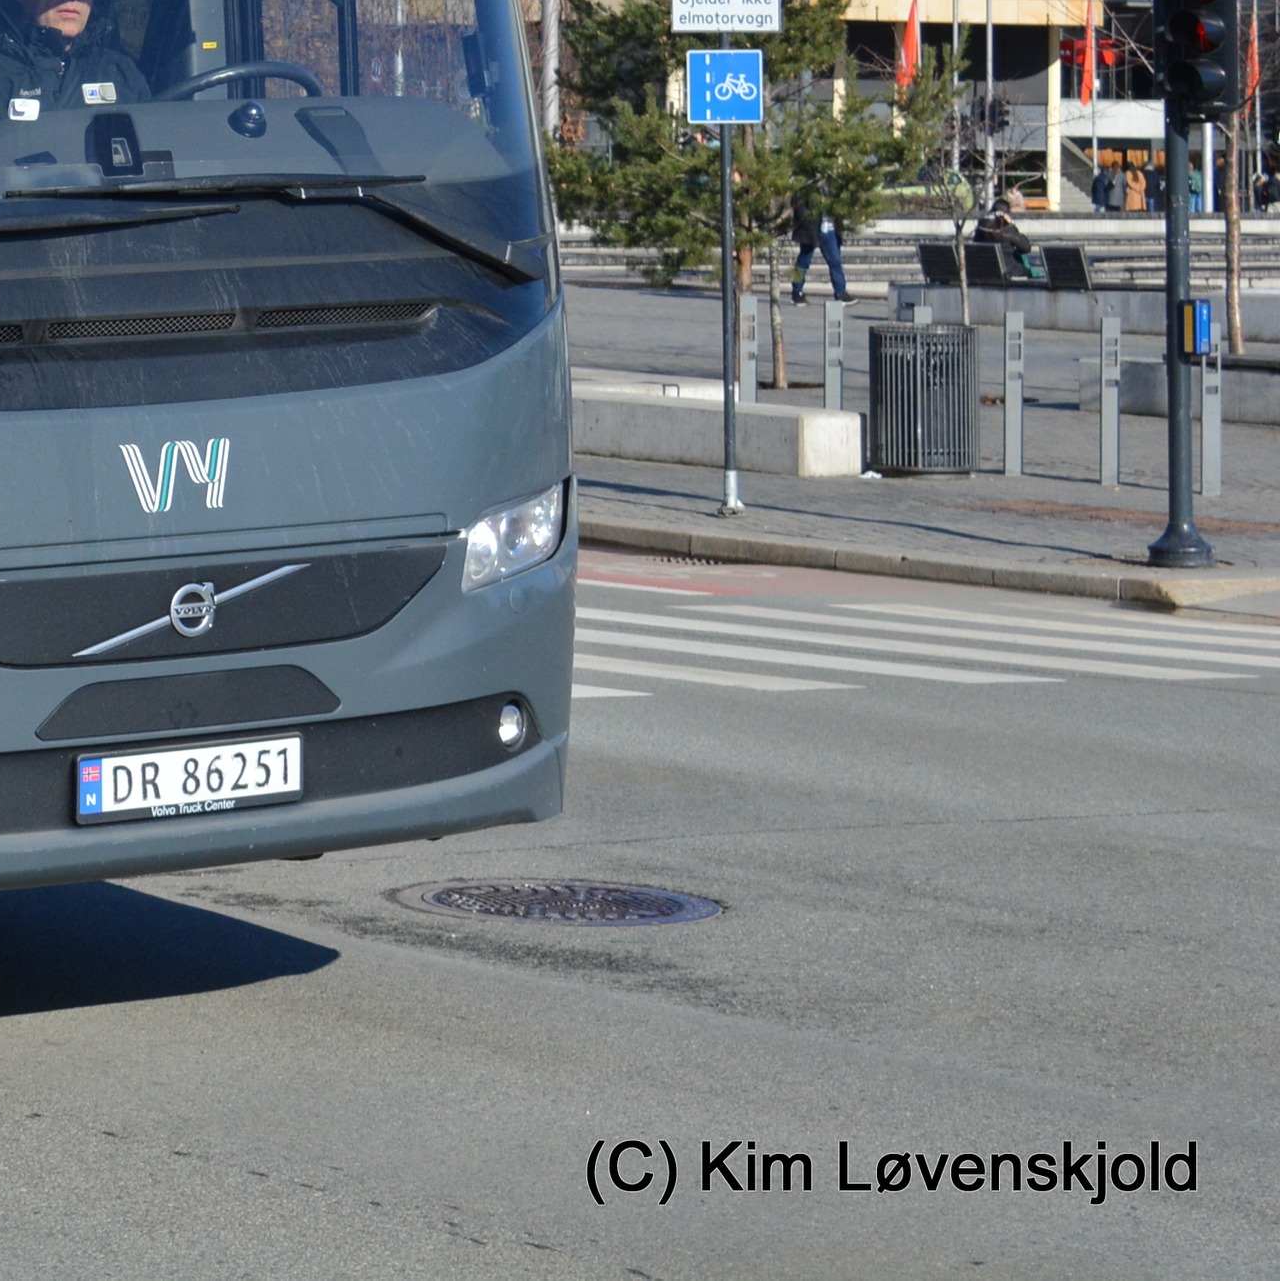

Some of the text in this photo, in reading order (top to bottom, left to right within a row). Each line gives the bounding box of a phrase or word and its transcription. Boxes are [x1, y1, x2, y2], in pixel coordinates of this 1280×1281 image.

[679, 12, 773, 27] elmotorvogn
[173, 605, 213, 616] VOLVO
[112, 748, 289, 805] DR 86251
[86, 793, 97, 807] N
[151, 799, 236, 817] Volvo Truck Center
